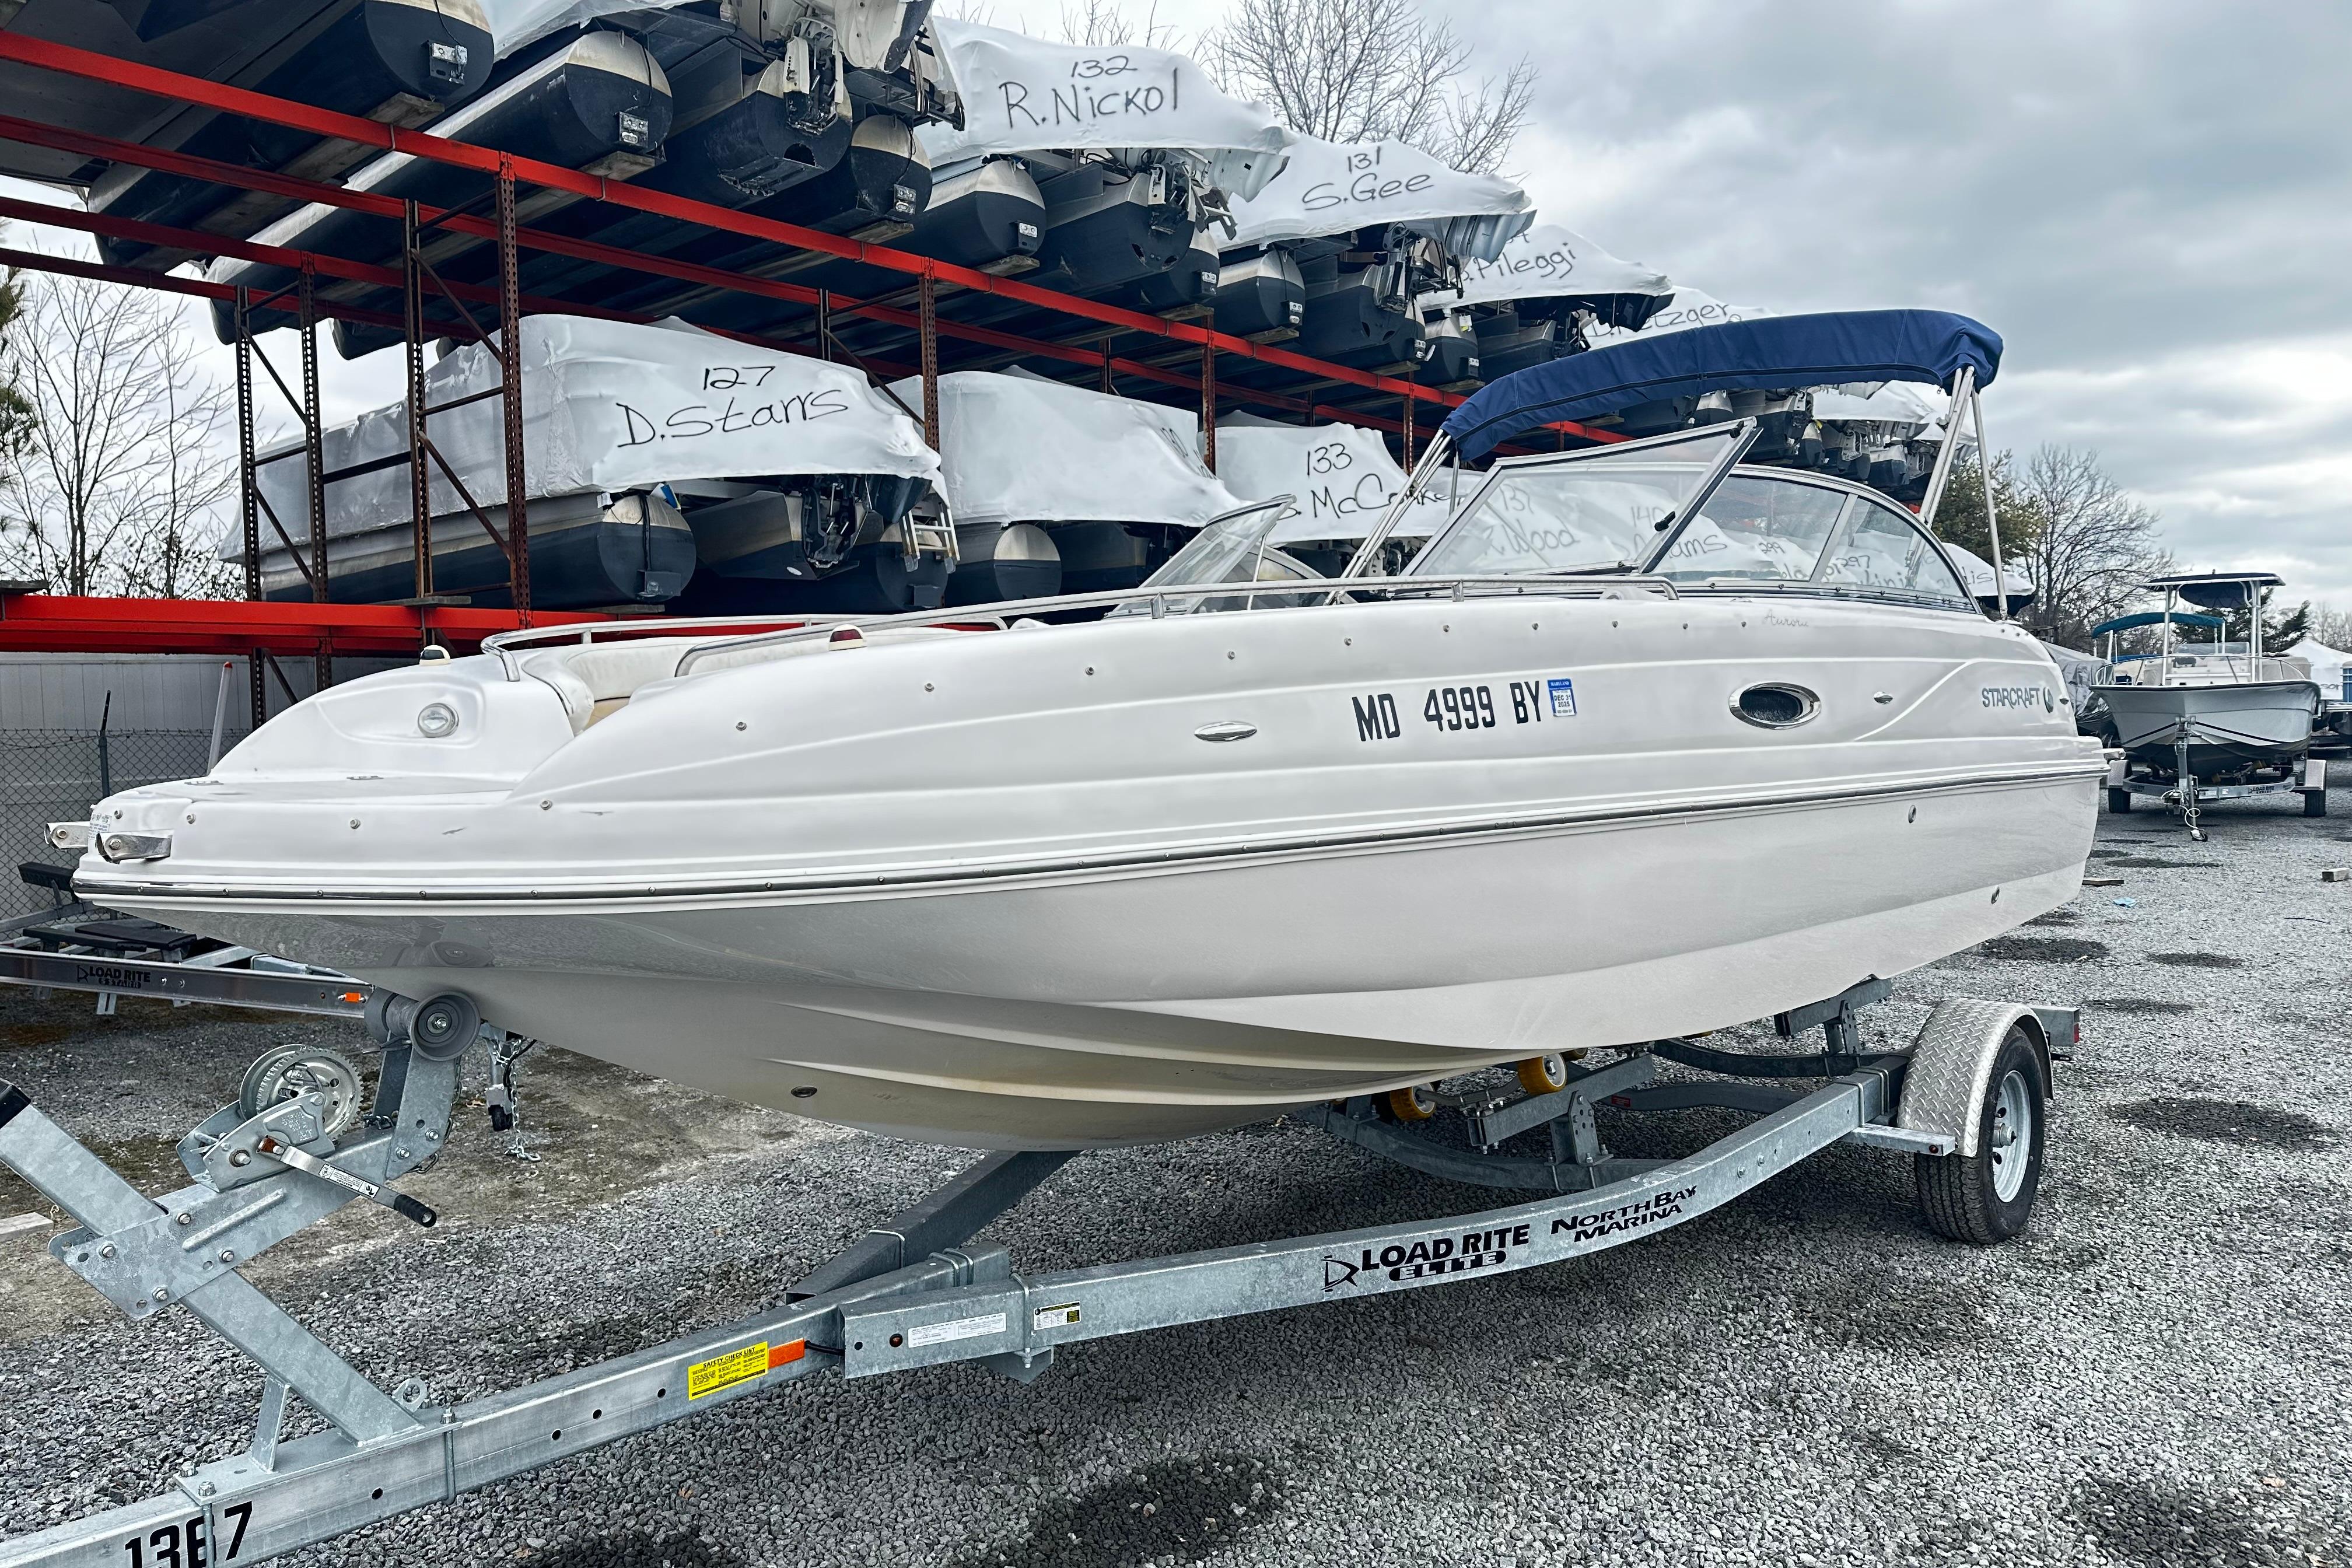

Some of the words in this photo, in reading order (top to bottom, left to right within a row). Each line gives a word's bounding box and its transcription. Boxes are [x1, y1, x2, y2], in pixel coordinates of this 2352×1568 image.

[1071, 55, 1138, 78] 132
[1348, 146, 1381, 174] 131
[703, 366, 776, 390] 127
[1307, 443, 1353, 476] 133
[1836, 555, 1871, 569] 297
[1352, 693, 1401, 742] MD
[1423, 685, 1496, 732] 4999
[1509, 680, 1541, 724] BY
[1982, 687, 2040, 709] STARCRAFT
[89, 965, 121, 979] LOAD
[124, 970, 150, 982] RITE
[1550, 1200, 1651, 1234] NORTH
[1654, 1185, 1697, 1208] BAY
[1574, 1204, 1682, 1242] MARINA
[1362, 1237, 1454, 1271] LOAD
[1462, 1223, 1530, 1255] RITE
[1399, 1252, 1497, 1280] ELITE
[725, 1352, 743, 1361] CHECK
